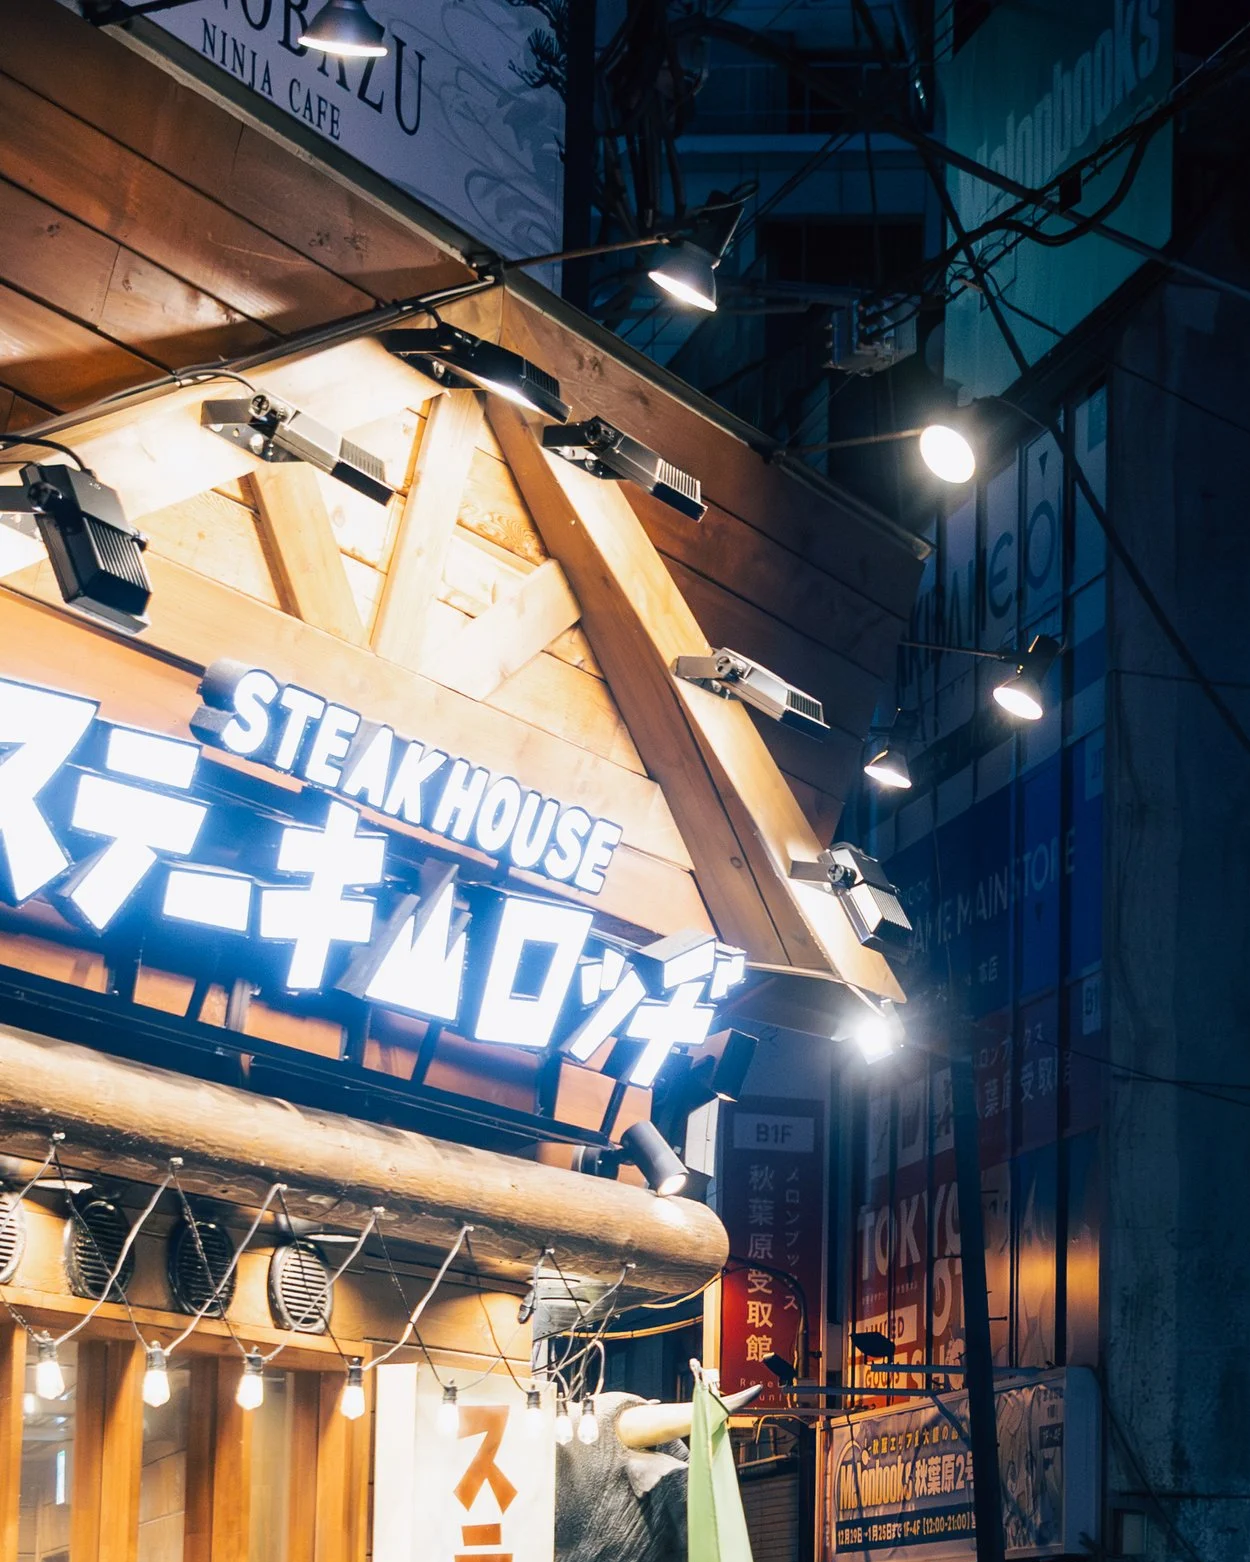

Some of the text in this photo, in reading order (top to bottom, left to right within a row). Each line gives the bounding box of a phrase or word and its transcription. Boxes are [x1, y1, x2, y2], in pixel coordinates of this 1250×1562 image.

[202, 18, 341, 141] NINJA CAFE
[756, 1122, 792, 1145] B1F
[745, 1164, 776, 1362] 秋葉原受取館
